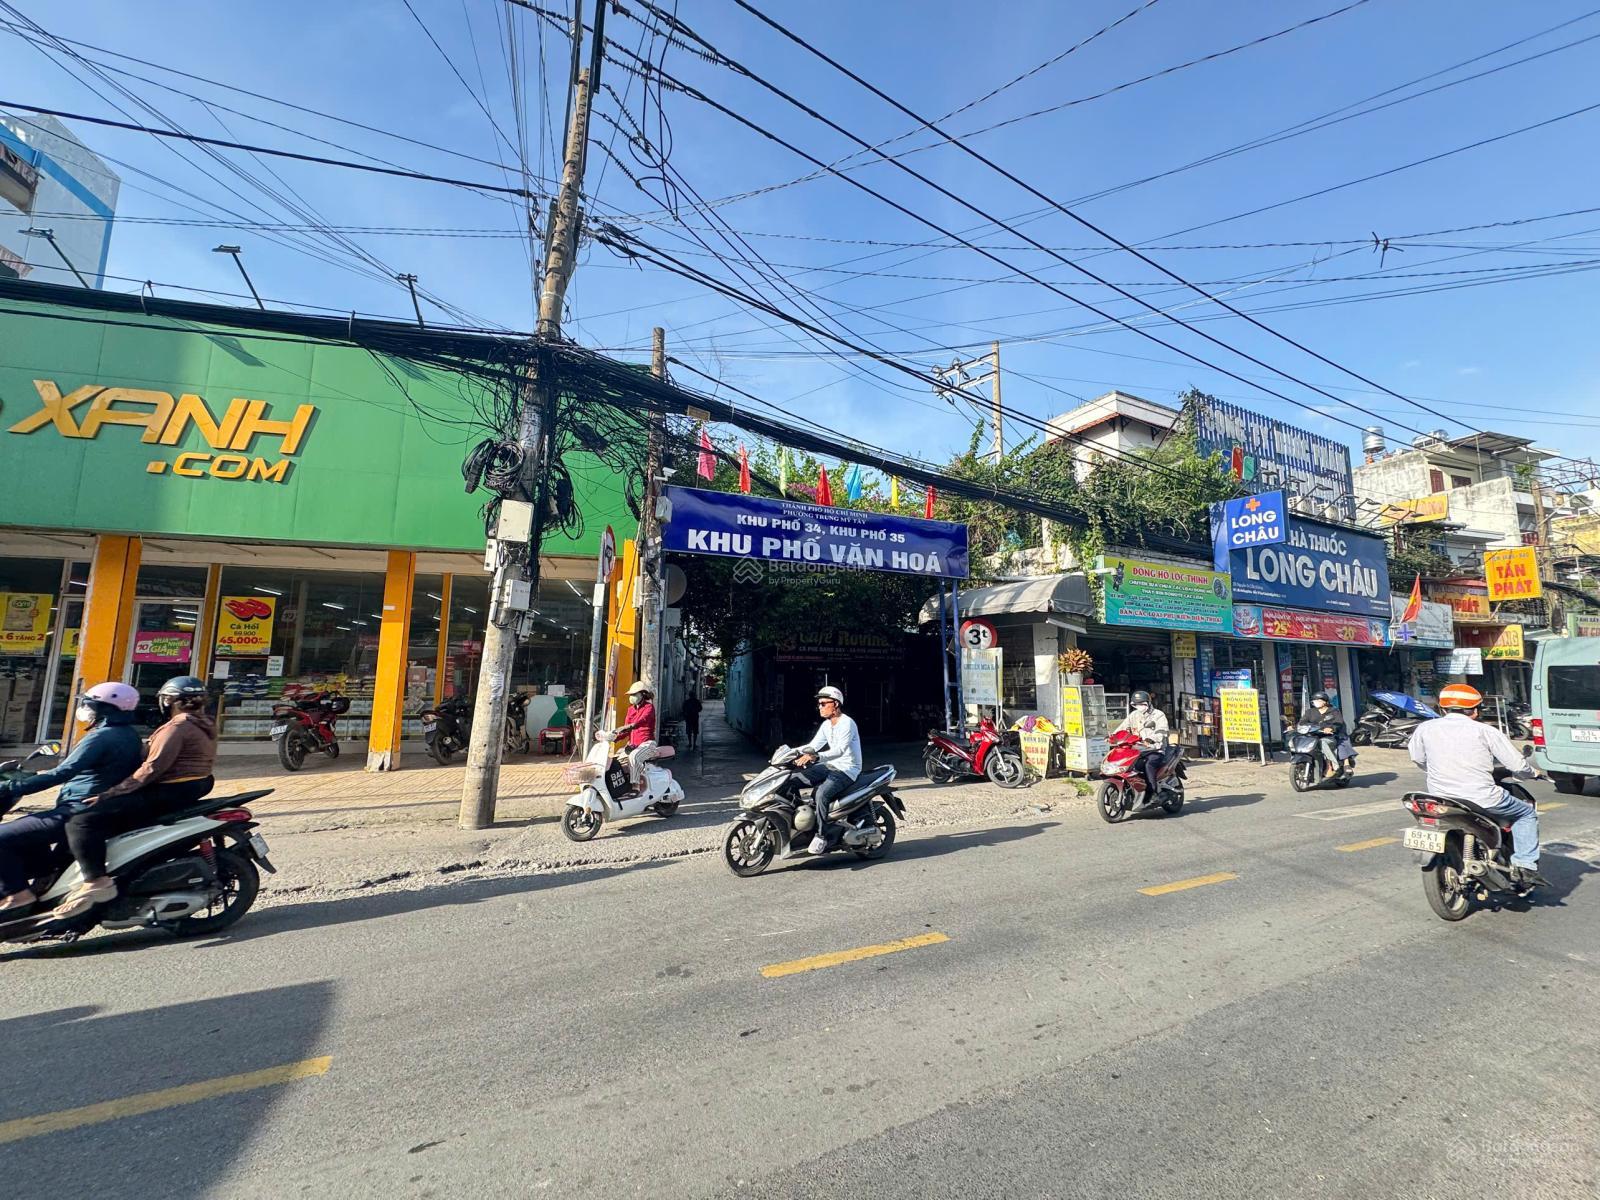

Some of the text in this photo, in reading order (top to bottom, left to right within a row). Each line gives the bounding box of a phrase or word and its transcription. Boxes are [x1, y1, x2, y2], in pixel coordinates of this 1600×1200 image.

[6, 379, 316, 454] XANH
[146, 452, 291, 482] .COM
[850, 510, 868, 518] MINH
[1231, 511, 1277, 528] LONG
[737, 514, 905, 543] KHU PHỐ 34, KHU PHỐ 35
[1232, 526, 1279, 545] CHÂU
[687, 529, 942, 574] KHU PHỐ VĂN HOÁ
[1309, 532, 1348, 556] THUỐC
[1247, 547, 1379, 598] LONG CHÂU
[1494, 578, 1532, 595] PHÁT
